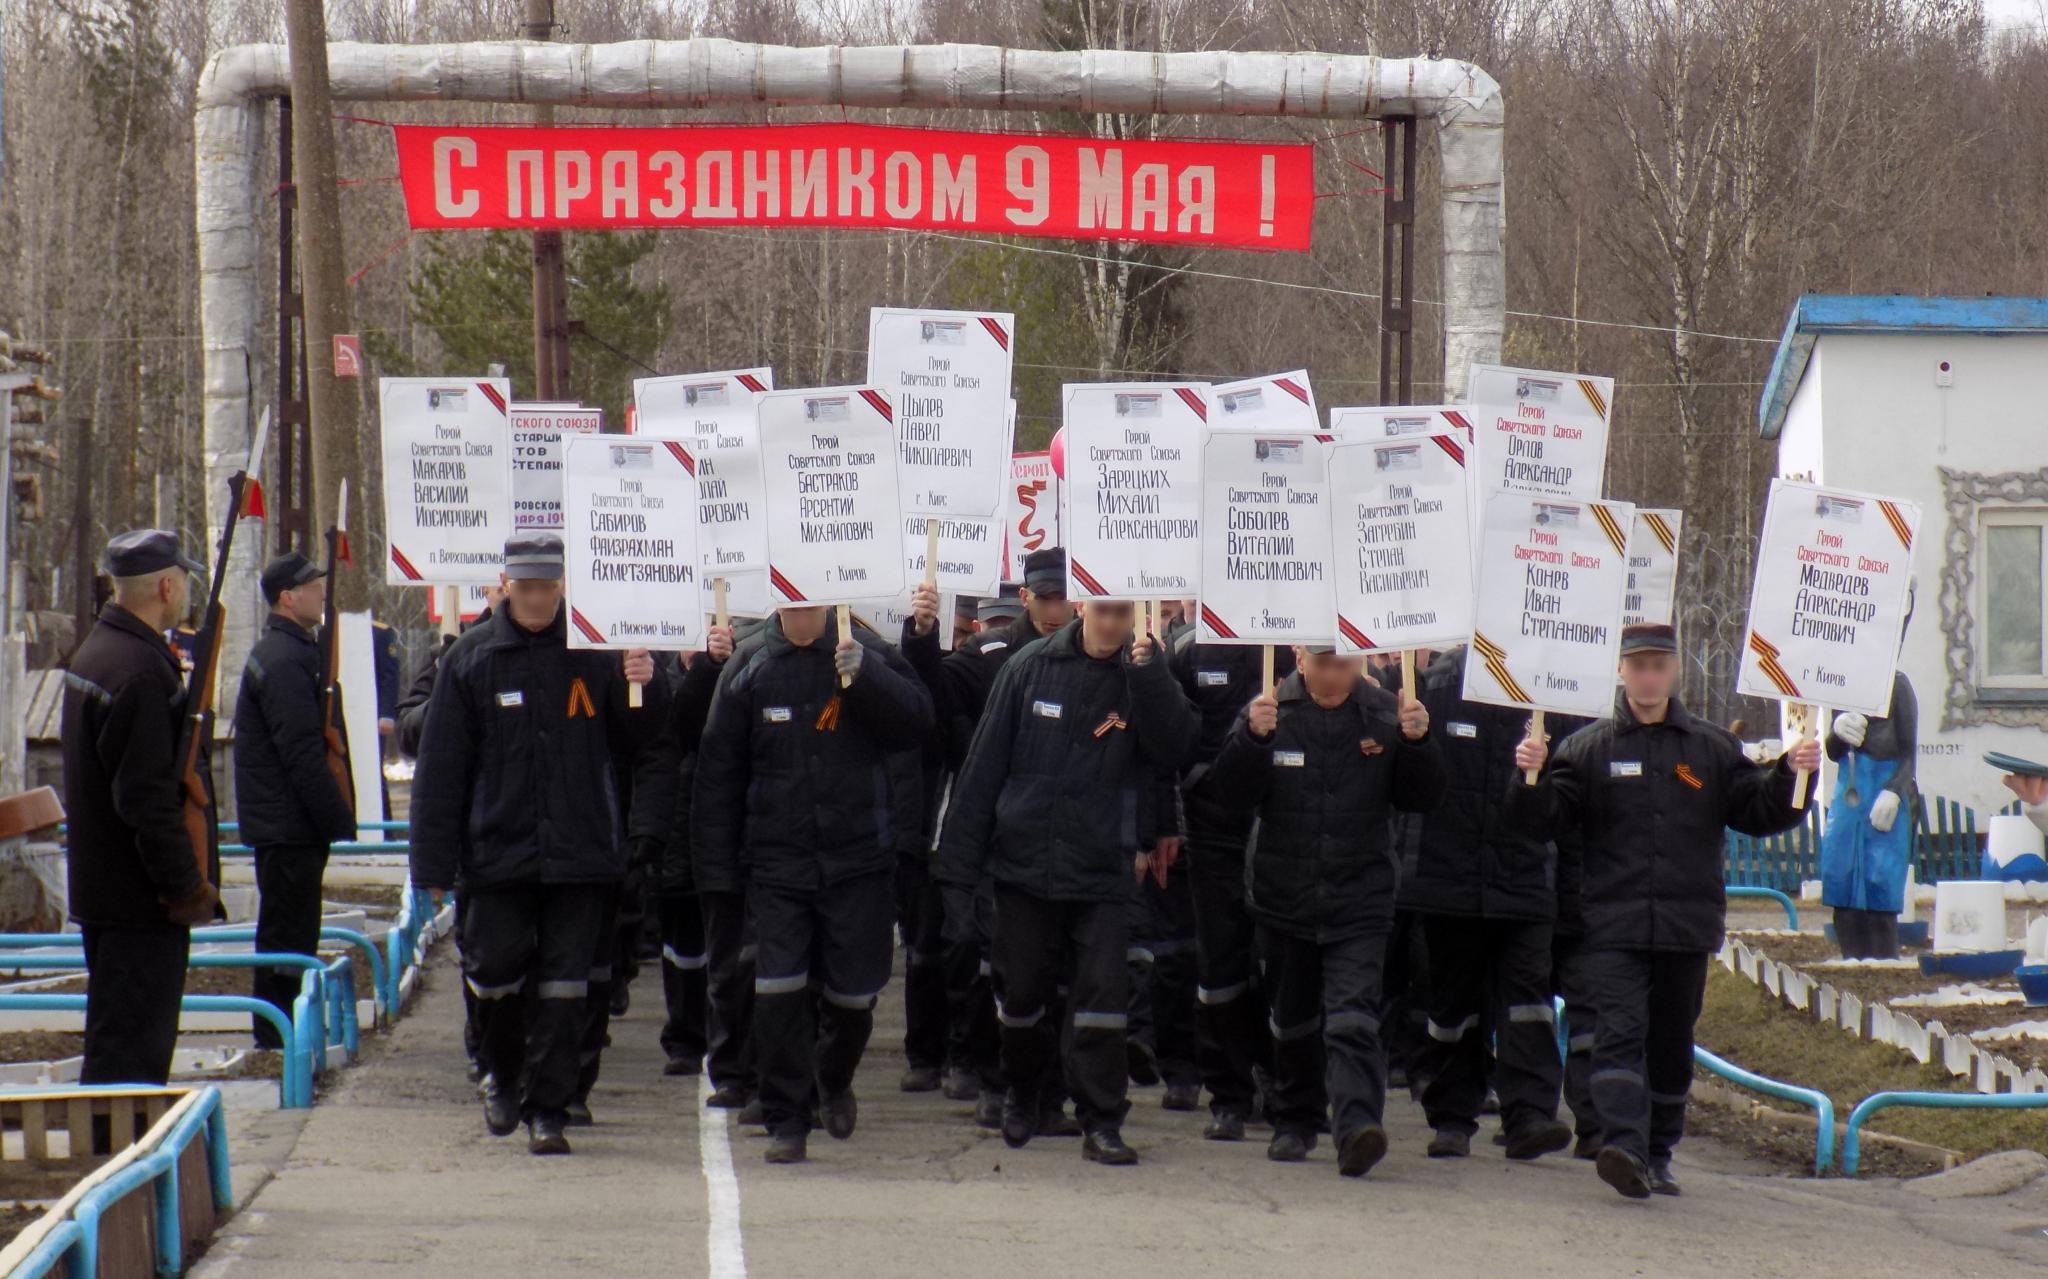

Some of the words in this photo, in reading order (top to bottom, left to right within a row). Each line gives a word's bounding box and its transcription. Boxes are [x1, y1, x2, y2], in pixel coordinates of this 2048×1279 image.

[433, 136, 480, 219] С
[506, 147, 977, 223] ПРАЗДНИКОМ
[1005, 145, 1050, 226] 9
[1259, 154, 1276, 237] !
[928, 355, 951, 371] Герой
[900, 370, 947, 388] Советского
[953, 373, 980, 389] Союза
[901, 392, 944, 418] Цылев
[1517, 401, 1545, 420] Герой
[435, 423, 461, 440] Герой
[556, 417, 597, 429] СОЮЗА
[900, 417, 940, 442] Павел
[1496, 416, 1546, 437] Советского
[1553, 424, 1583, 440] Союза
[716, 433, 744, 449] Союза
[811, 434, 840, 450] Герой
[1124, 428, 1151, 445] Герой
[1508, 434, 1544, 459] Орлов
[411, 441, 462, 457] Советского
[465, 441, 493, 457] Союза
[788, 453, 841, 470] Советского
[847, 451, 875, 467] Союза
[899, 441, 972, 468] Николаевич
[1090, 445, 1143, 462] Советского
[1150, 445, 1181, 461] Союза
[412, 459, 467, 480] Макаров
[1098, 462, 1171, 491] Зарецких
[1262, 471, 1287, 488] Герой
[1504, 457, 1572, 487] Александр
[414, 482, 469, 504] Василий
[620, 477, 643, 493] Герой
[798, 471, 859, 494] Бастраков
[1389, 483, 1413, 500] Герой
[591, 492, 633, 508] Советского
[640, 494, 664, 509] Союза
[799, 494, 855, 519] Арсентий
[1096, 489, 1160, 515] Михаил
[1228, 486, 1280, 504] Советского
[1287, 487, 1318, 504] Союза
[415, 506, 488, 528] Иосифович
[1228, 506, 1290, 531] Соболев
[1358, 502, 1410, 520] Советского
[1413, 497, 1443, 515] Союза
[590, 510, 647, 533] Сабиров
[800, 519, 874, 544] Михайлович
[905, 517, 988, 543] Лавнтьевич
[1357, 520, 1417, 544] Загребин
[1227, 531, 1294, 556] Виталий
[1529, 527, 1558, 546] Герой
[1816, 529, 1844, 549] Герой
[716, 546, 745, 565] Киров
[915, 555, 974, 575] Анасьево
[1358, 545, 1405, 570] Степан
[1514, 543, 1564, 565] Советского
[1571, 551, 1601, 569] Союза
[1797, 545, 1850, 569] Советского
[1858, 555, 1890, 575] Союза
[591, 558, 693, 583] Ахметзянович
[838, 565, 867, 582] Киров
[1140, 569, 1186, 589] Кильмезь
[1227, 556, 1323, 581] Максимович
[1526, 562, 1569, 591] Конев
[1799, 563, 1869, 597] Медведев
[1359, 568, 1430, 595] Васильевич
[1524, 587, 1561, 615] Иван
[1795, 588, 1876, 624] Александр
[619, 620, 658, 636] Нижние
[660, 620, 686, 637] Шуни
[1261, 608, 1296, 630] Зуевка
[1387, 609, 1437, 630] Даровской
[1521, 611, 1607, 646] Степанович
[1791, 611, 1856, 645] Егорович
[1546, 671, 1579, 692] Киров
[1815, 665, 1847, 688] Киров
